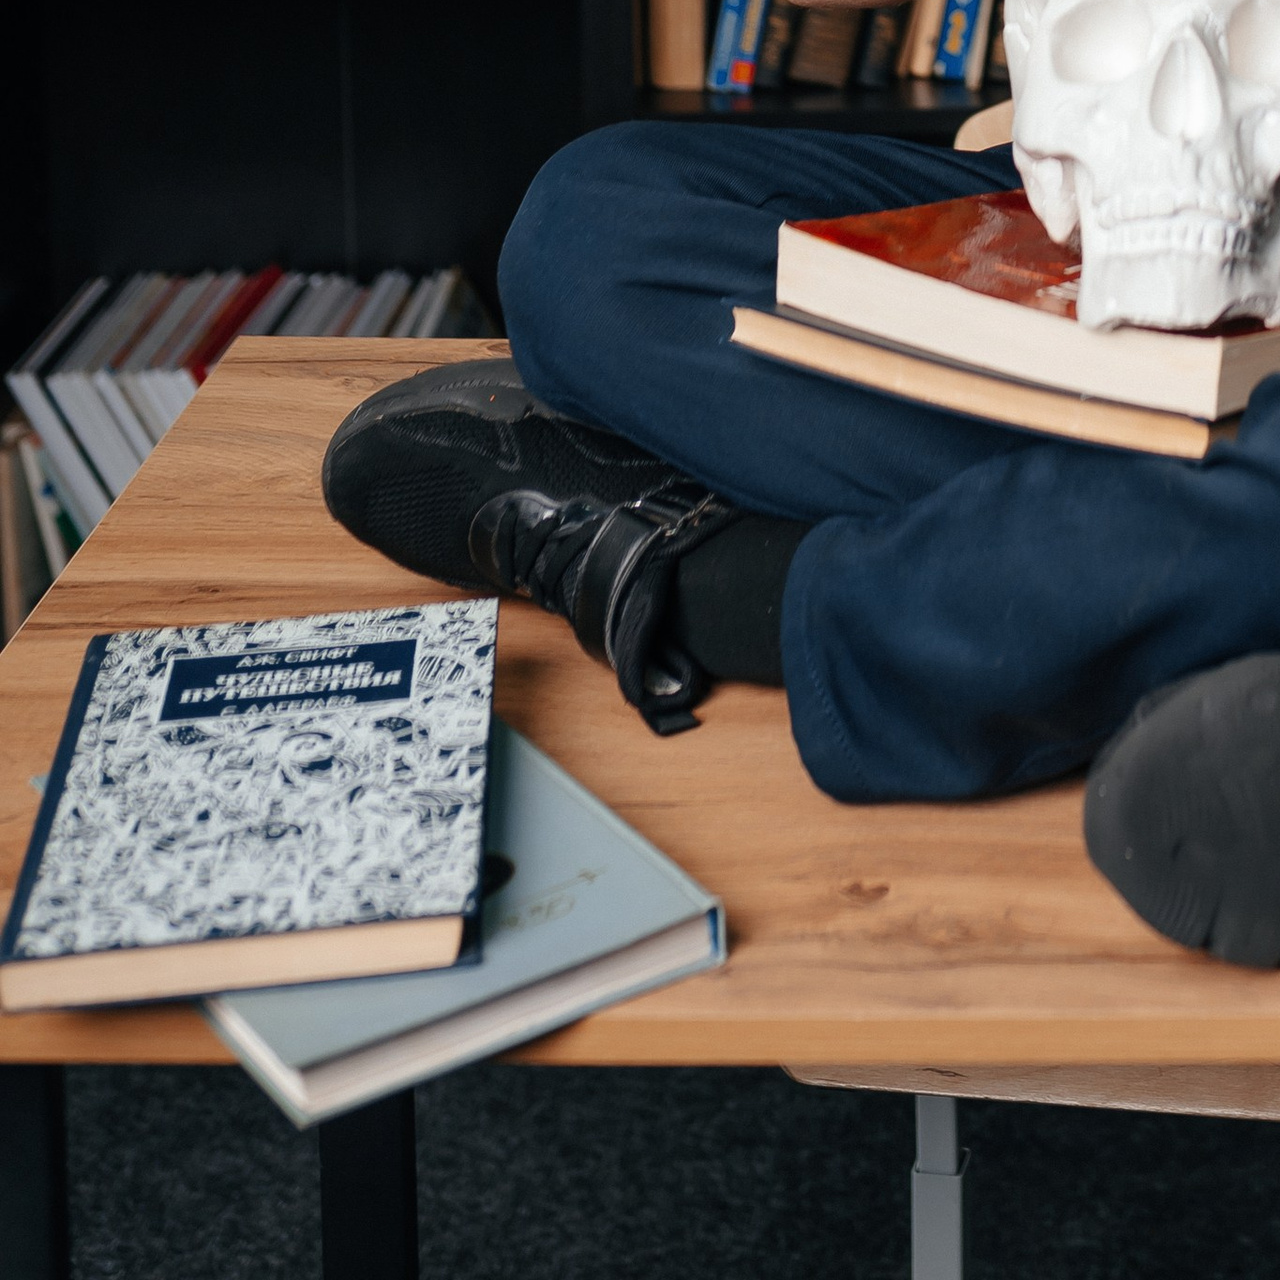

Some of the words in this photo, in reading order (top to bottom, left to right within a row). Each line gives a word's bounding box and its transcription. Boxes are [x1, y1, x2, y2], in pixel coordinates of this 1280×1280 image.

[284, 645, 359, 665] СВИФТ
[179, 669, 403, 705] ПУТЕШЕСТВИЯ
[215, 660, 375, 688] ЧУДЕСНЫЕ
